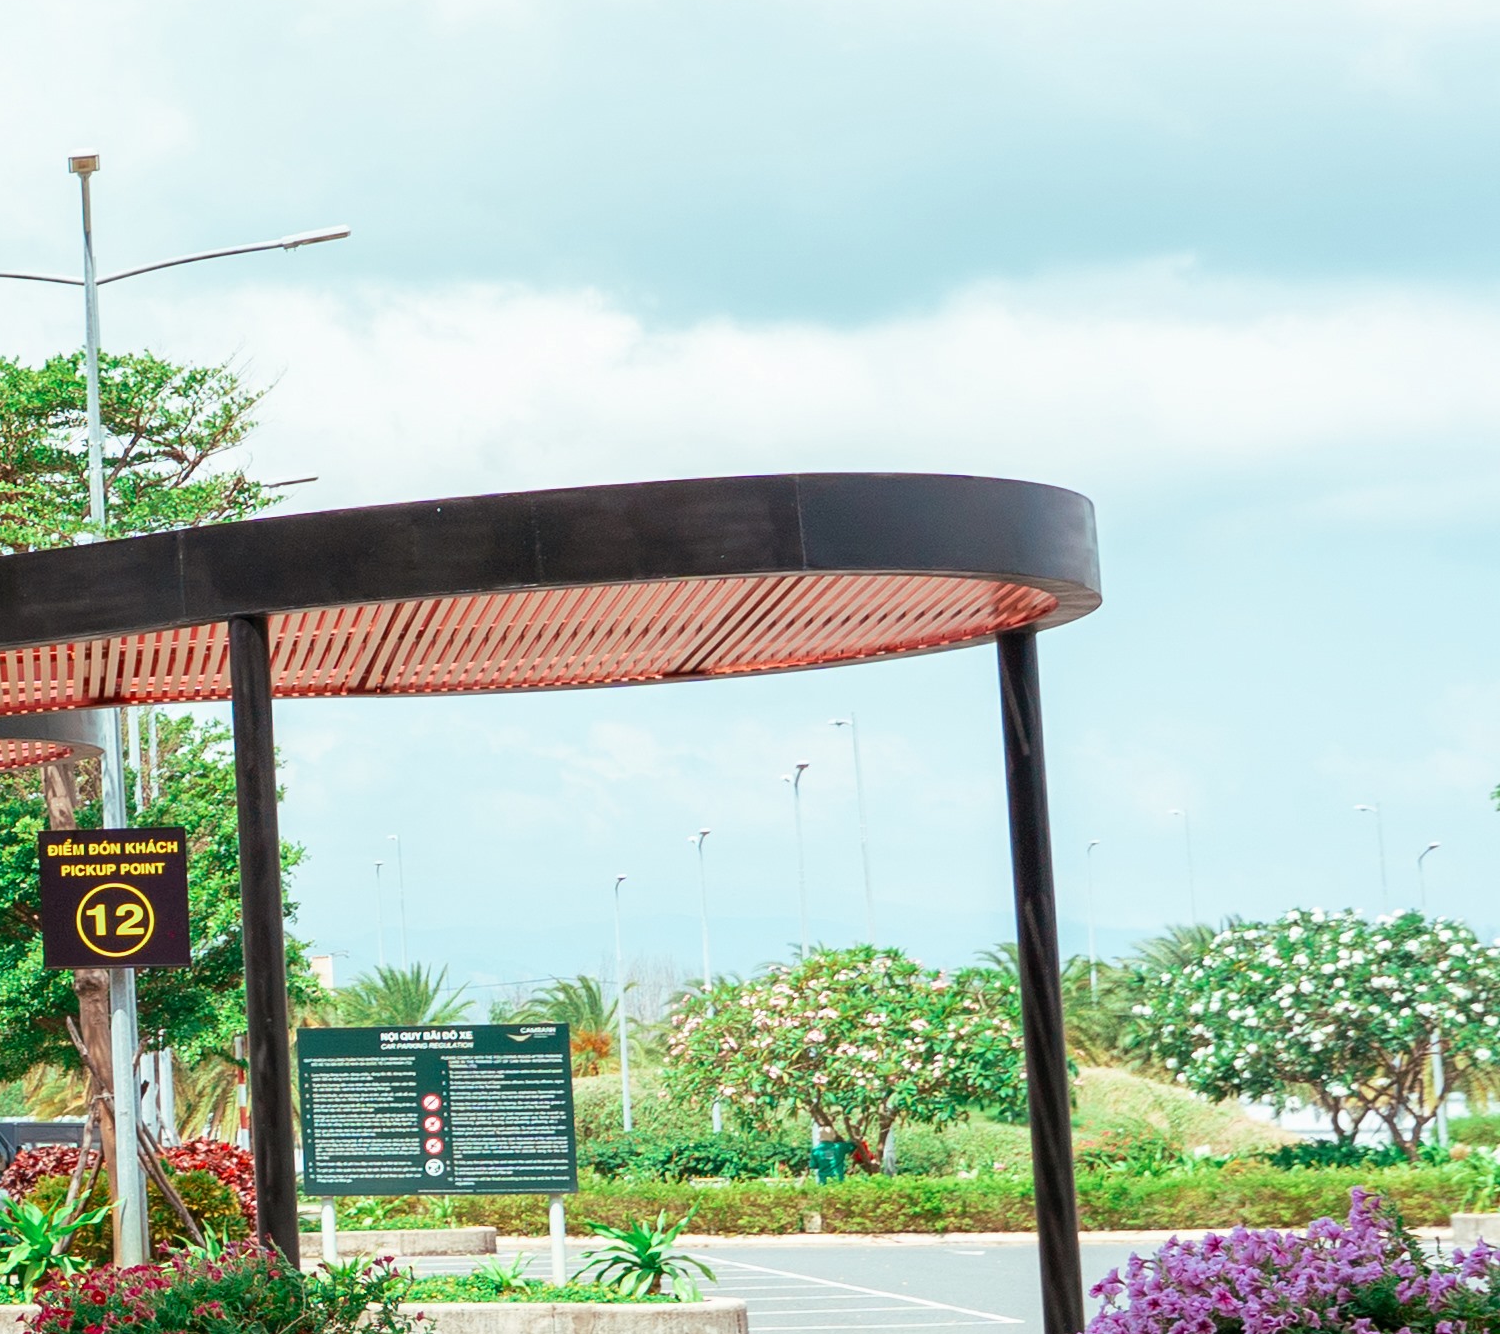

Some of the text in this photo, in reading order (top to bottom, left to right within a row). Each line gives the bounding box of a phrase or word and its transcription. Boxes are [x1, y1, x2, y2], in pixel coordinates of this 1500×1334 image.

[47, 839, 178, 856] ĐIỂM ĐÓN KHÁCH
[60, 862, 165, 877] PICKUP POINT
[85, 903, 145, 936] 12
[400, 1032, 422, 1041] QUY
[459, 1031, 473, 1040] XE
